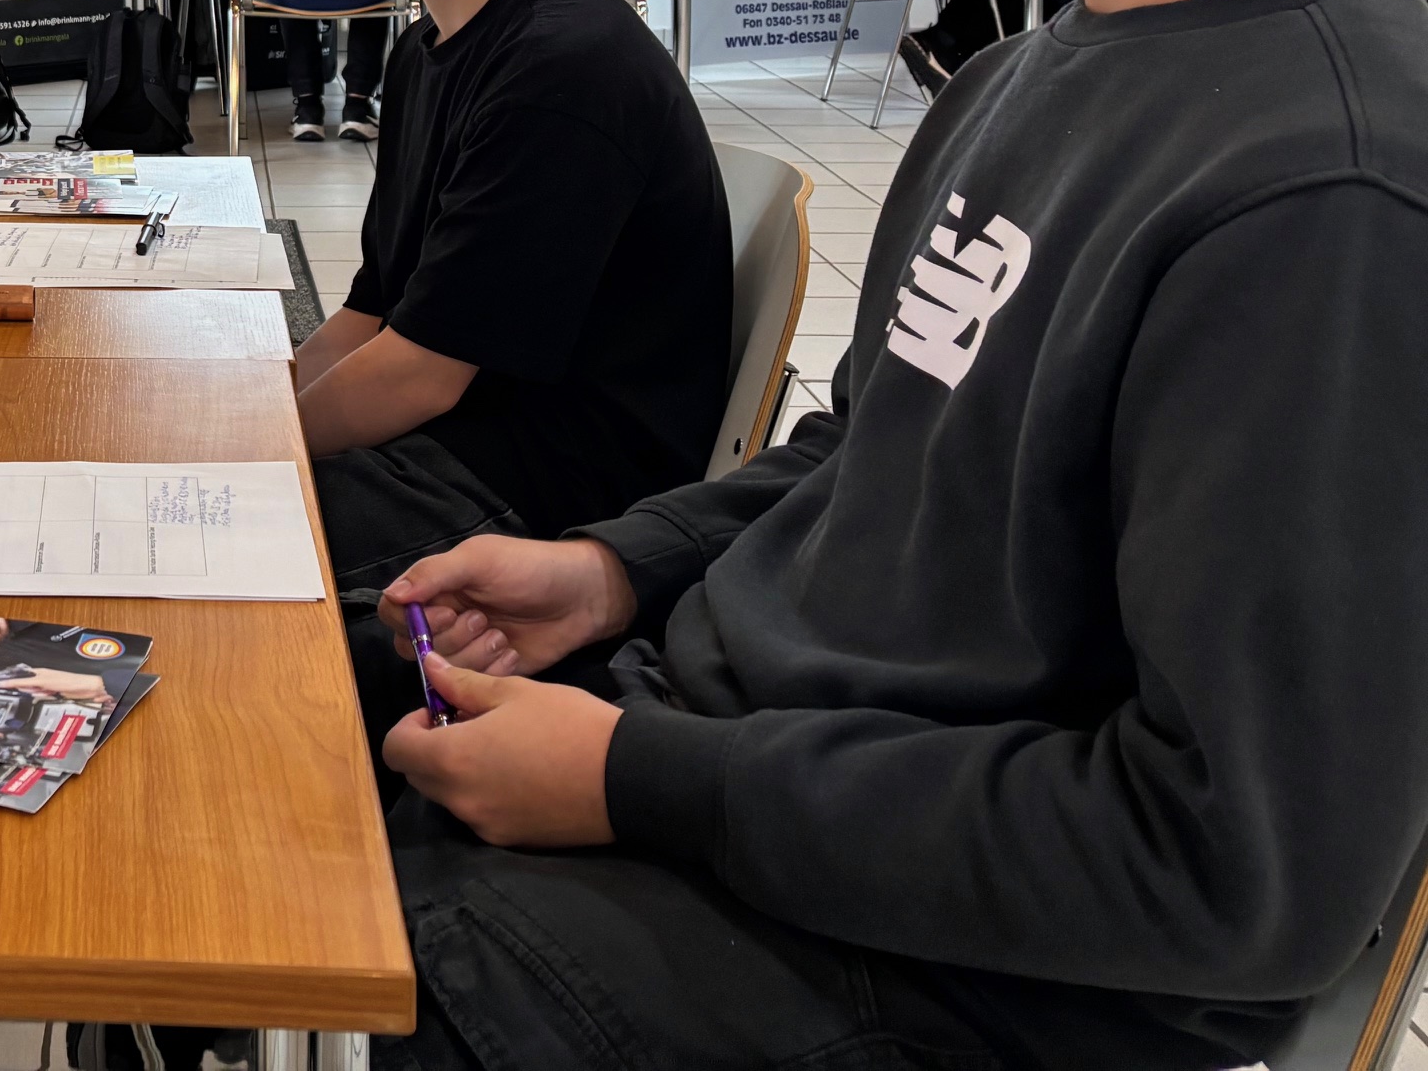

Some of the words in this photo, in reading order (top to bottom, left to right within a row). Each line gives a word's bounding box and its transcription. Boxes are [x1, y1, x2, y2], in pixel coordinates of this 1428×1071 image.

[735, 3, 767, 15] 06847
[13, 19, 30, 28] 4326
[743, 17, 762, 29] Fon
[766, 14, 809, 27] 0340-51
[828, 13, 841, 24] 48
[25, 33, 70, 44] brinkmanngala
